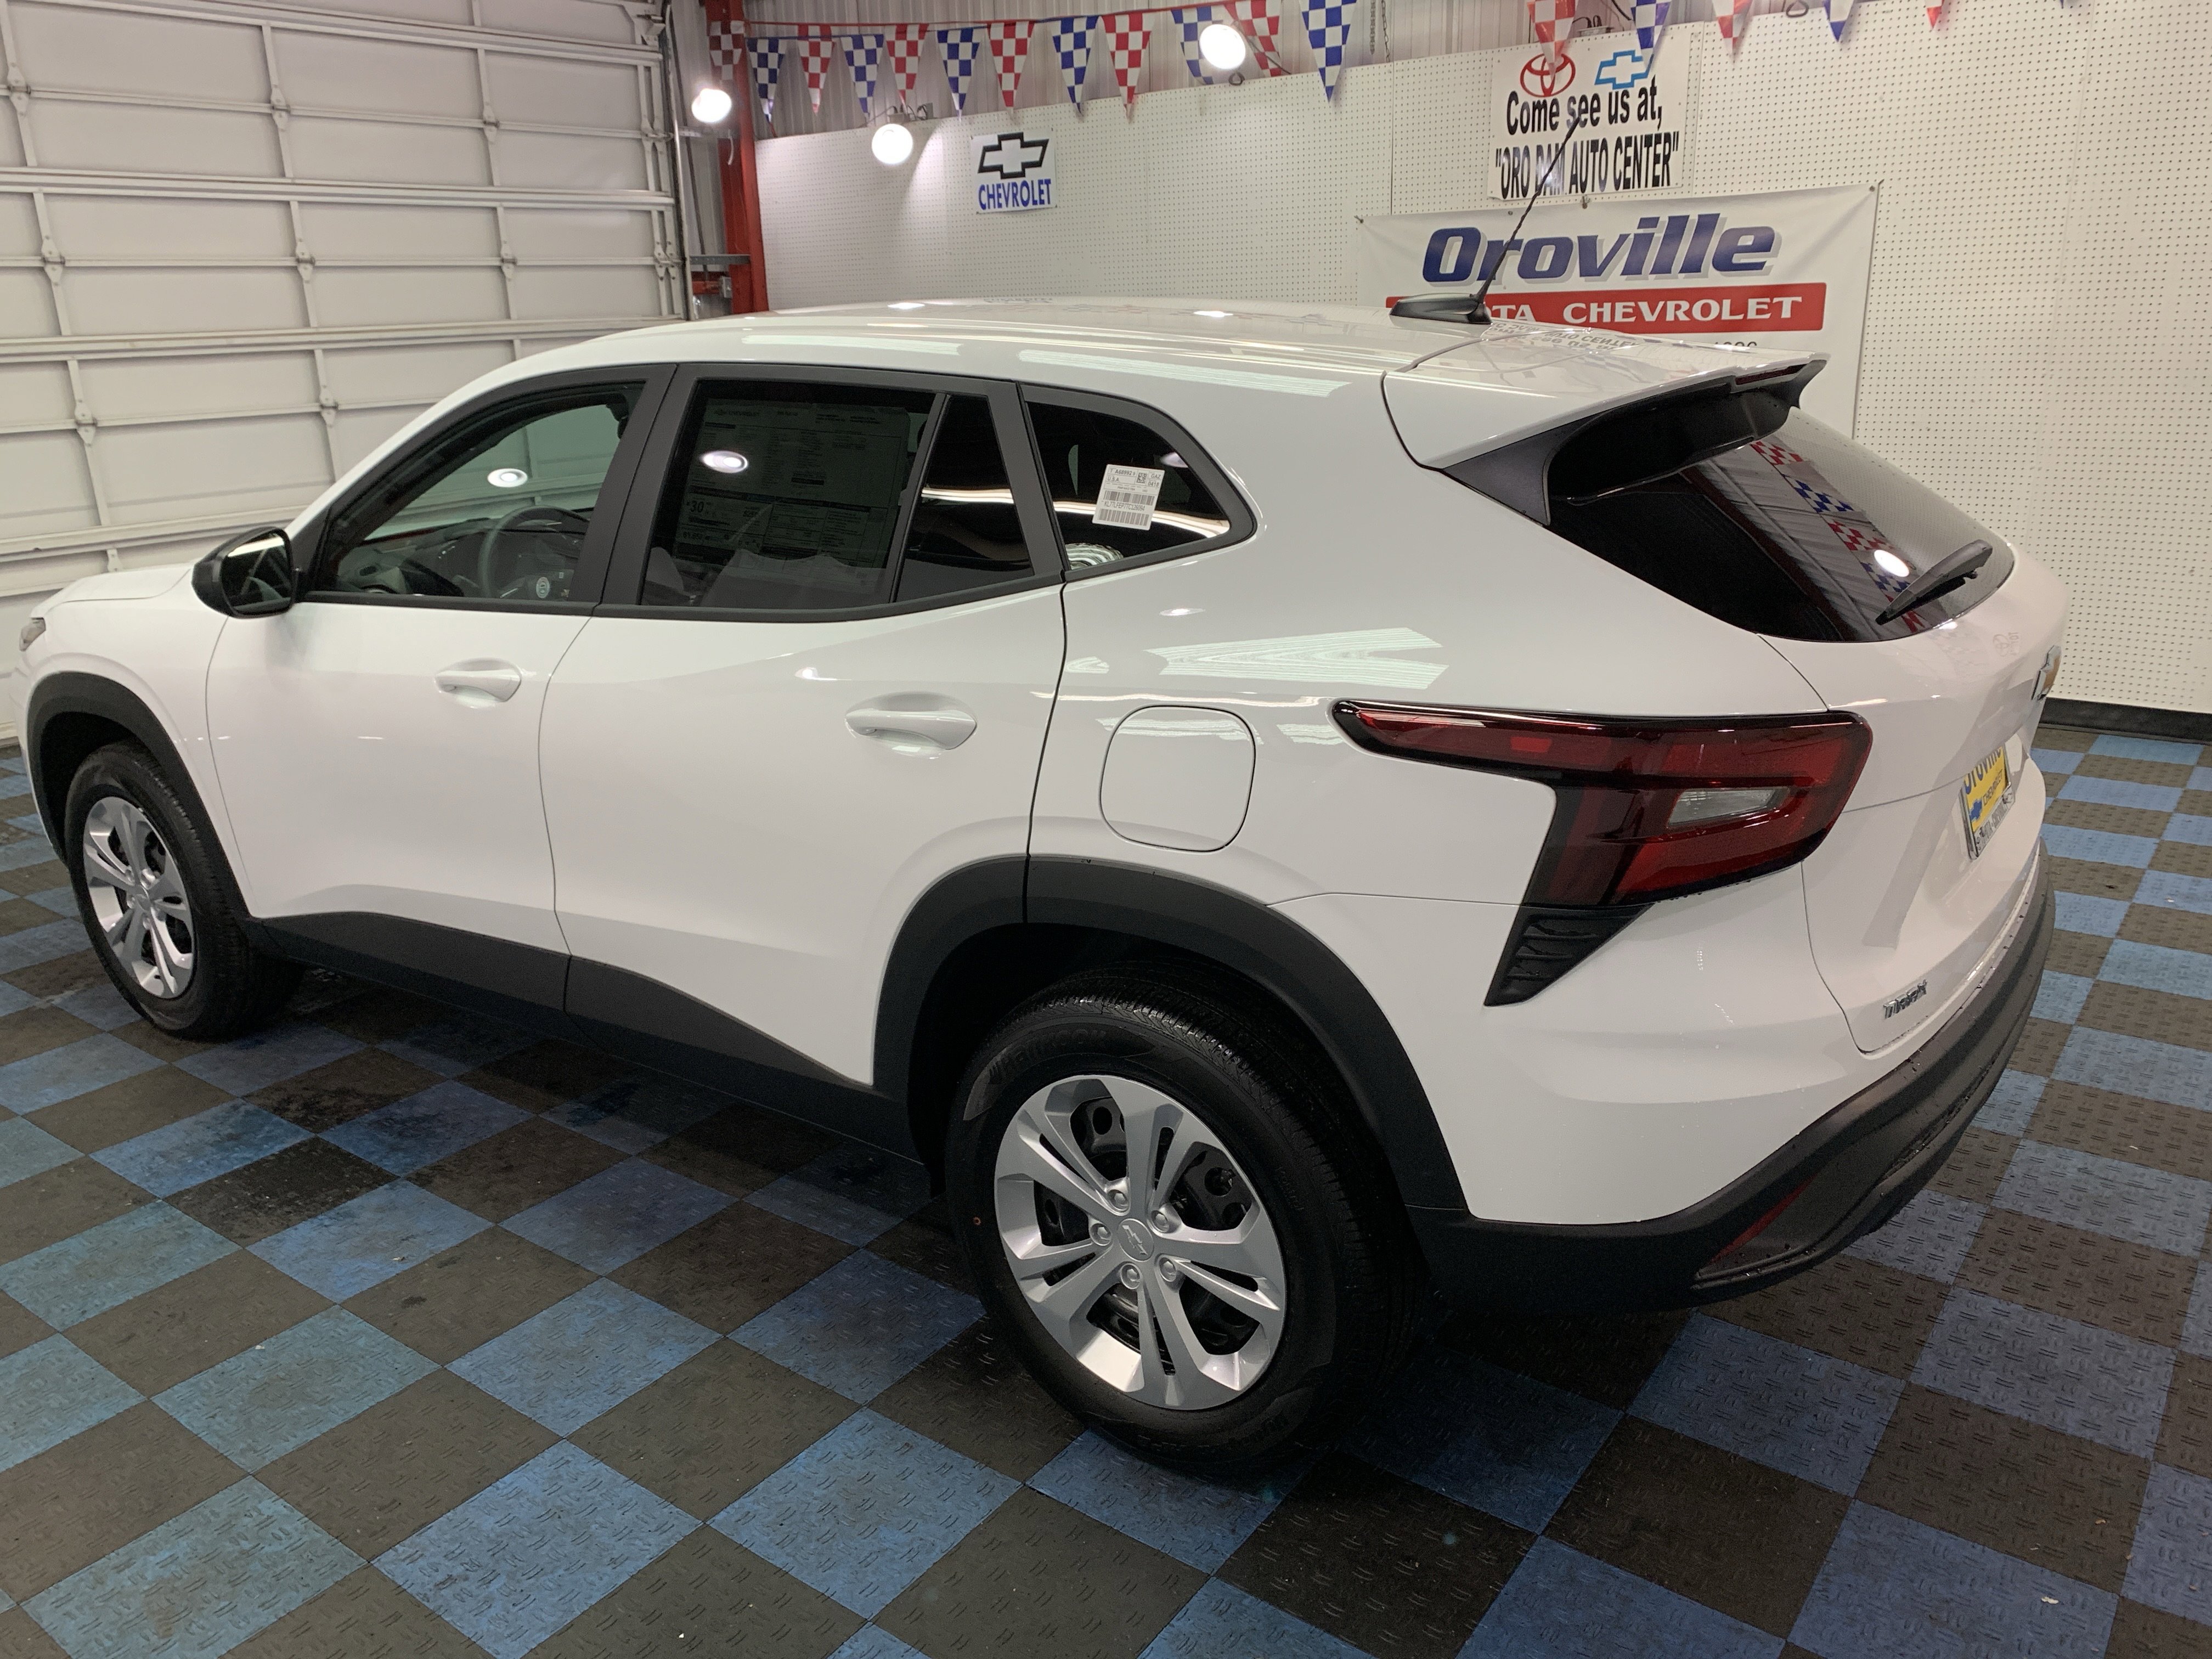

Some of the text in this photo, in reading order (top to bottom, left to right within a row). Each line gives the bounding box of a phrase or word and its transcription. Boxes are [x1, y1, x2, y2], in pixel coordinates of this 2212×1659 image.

[1506, 75, 1662, 136] Come see us at,
[1568, 137, 1609, 194] AUTO
[1613, 131, 1679, 191] CENTER"
[978, 178, 1051, 211] CHEVROLET
[1422, 212, 1778, 284] Oroville
[1563, 297, 1803, 324] CHEVROLET
